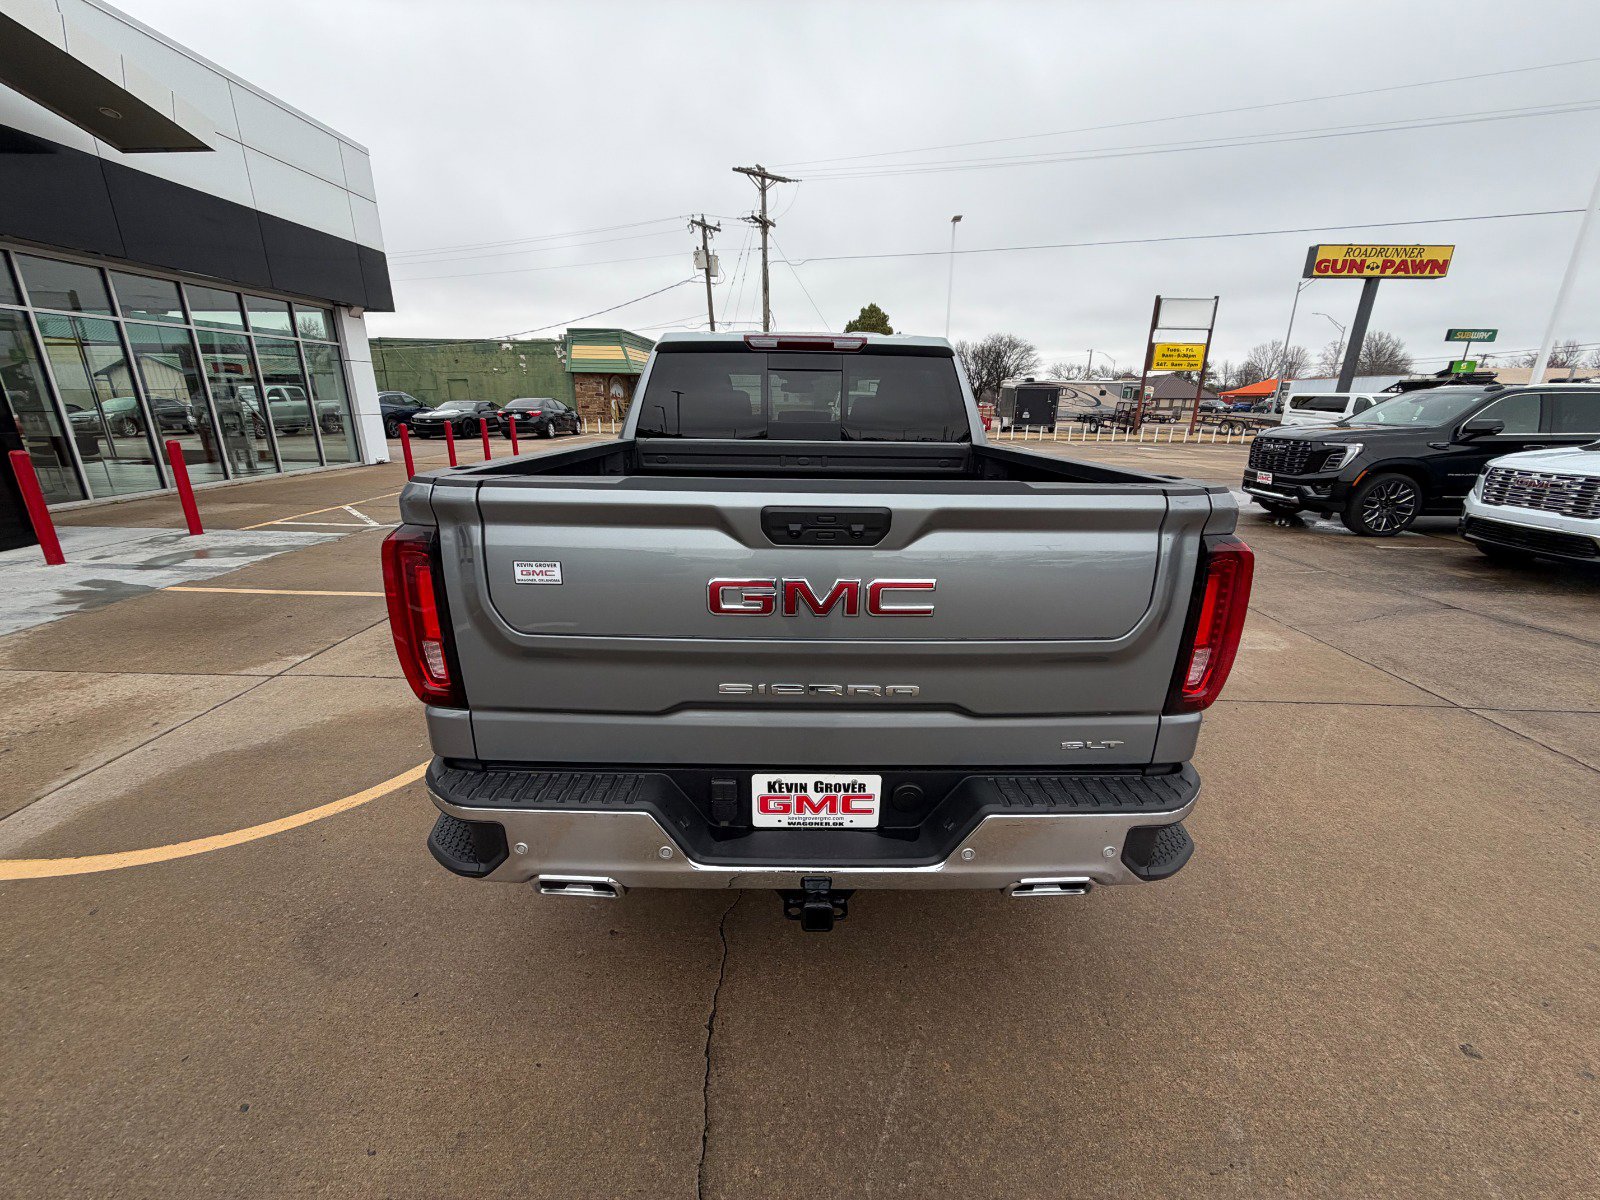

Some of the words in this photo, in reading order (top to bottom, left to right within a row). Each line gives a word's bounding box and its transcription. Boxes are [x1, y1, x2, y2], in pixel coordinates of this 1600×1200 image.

[1343, 247, 1426, 259] ROADRUNNER
[1315, 258, 1367, 274] GUN
[1379, 258, 1450, 275] PAWN
[1454, 331, 1493, 340] SUBWAY
[520, 569, 556, 577] GMC
[706, 577, 937, 617] GMC
[718, 683, 920, 697] SIERRA
[1060, 740, 1124, 750] SLT
[767, 780, 808, 794] KEVIN
[813, 780, 867, 794] GROVER
[757, 793, 876, 815] GMC
